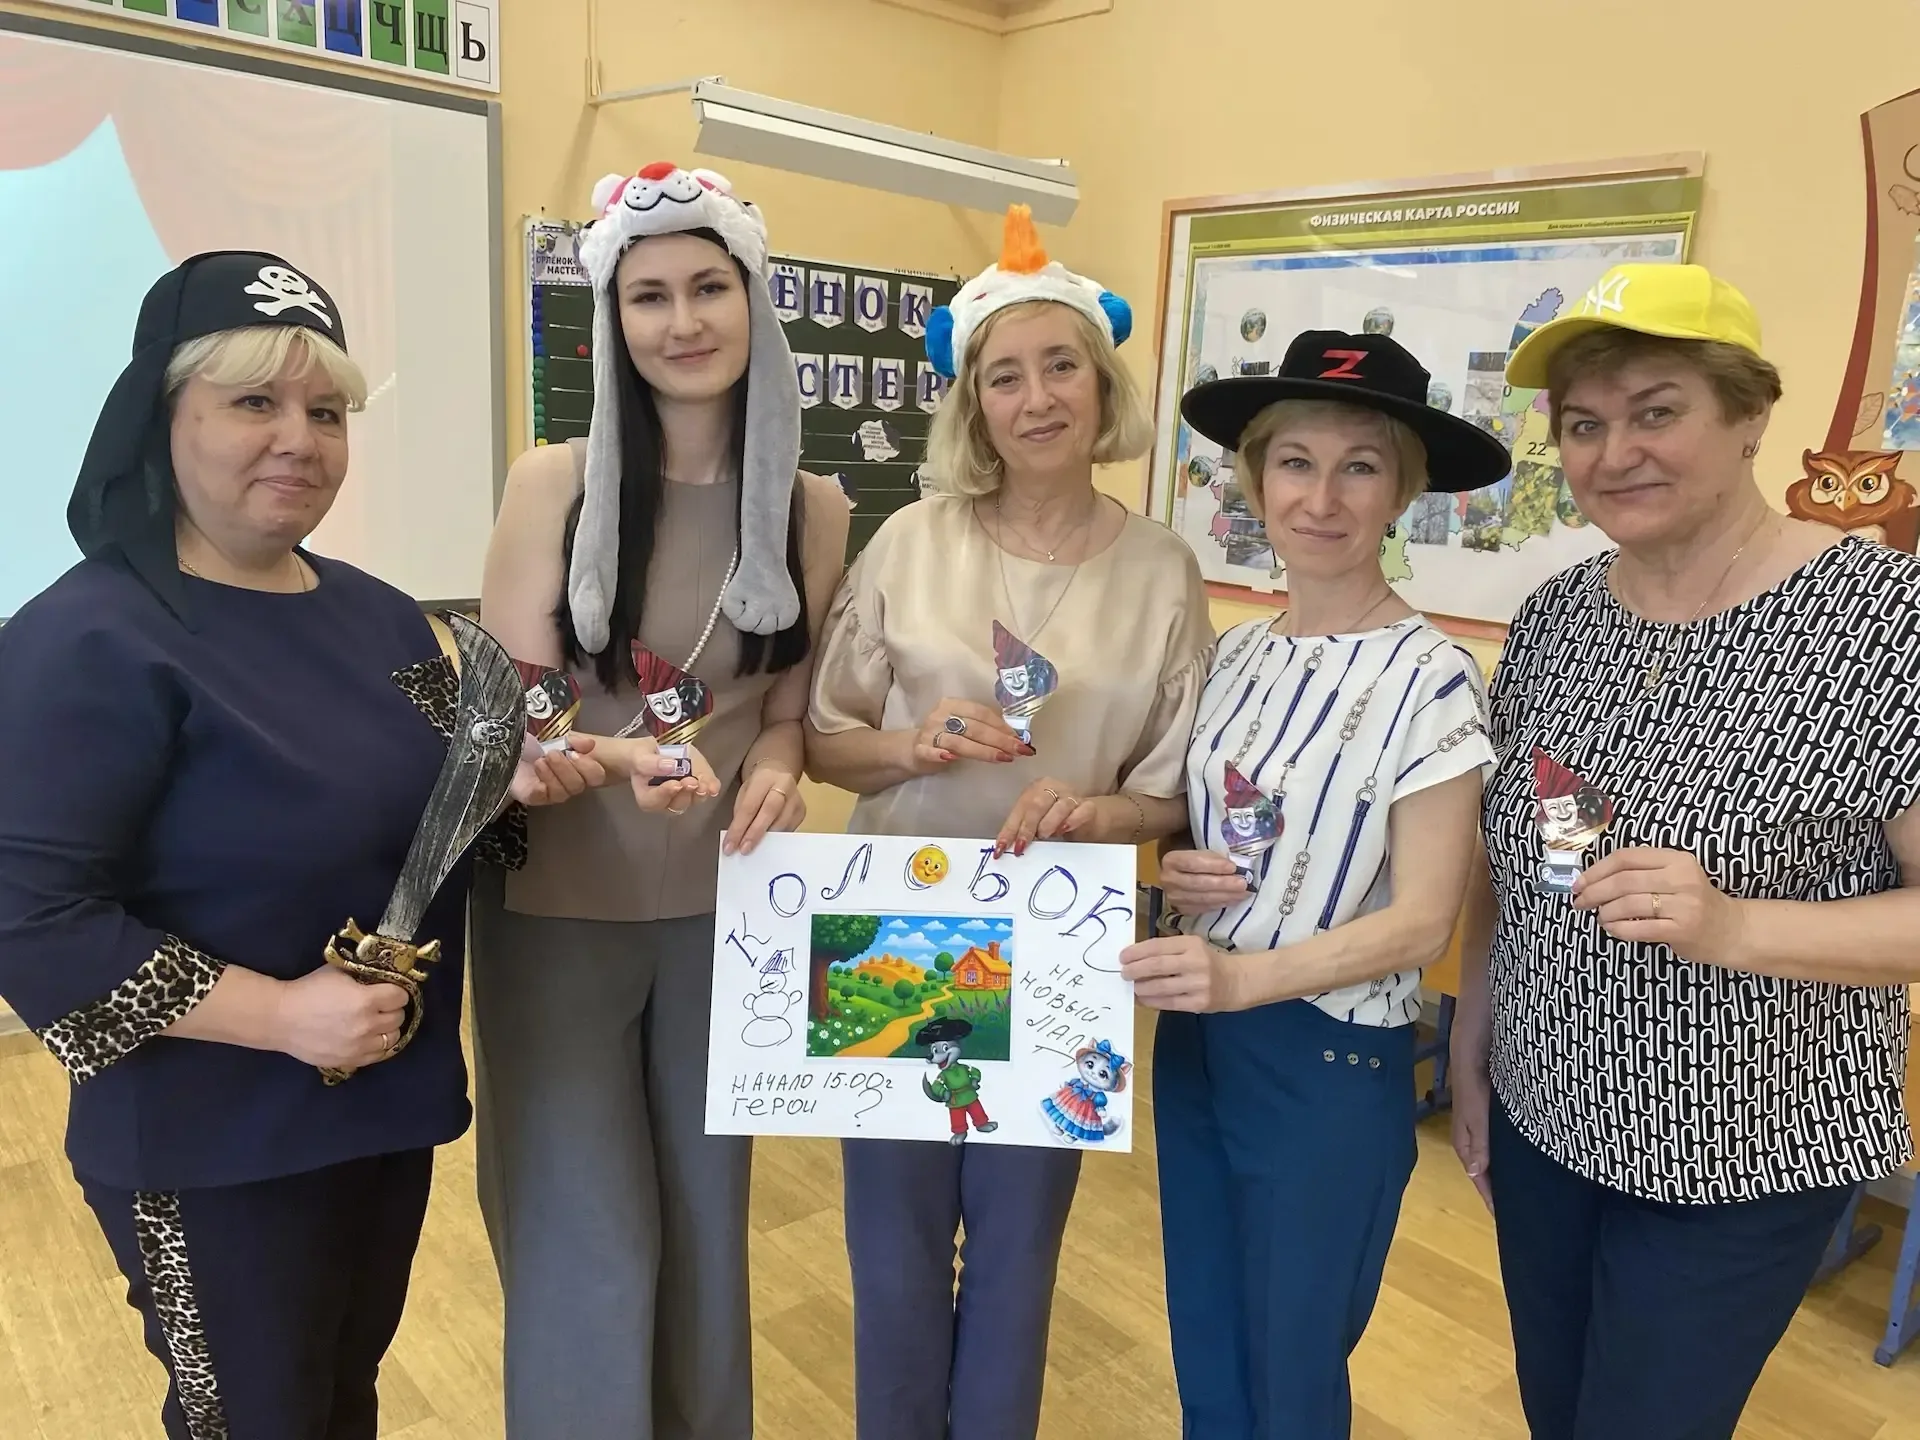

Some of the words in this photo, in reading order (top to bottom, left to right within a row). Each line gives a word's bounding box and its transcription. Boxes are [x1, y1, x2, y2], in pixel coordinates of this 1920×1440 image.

[373, 1, 403, 46] Ч
[416, 11, 448, 66] Щ
[460, 21, 487, 62] Ь
[1310, 208, 1402, 227] ФИЗИЧЕСКАЯ
[1405, 203, 1453, 221] КАРТА
[1456, 201, 1520, 217] РОССИИ
[1316, 349, 1370, 379] Z
[1526, 441, 1547, 456] 22
[1048, 963, 1085, 988] НА
[1019, 970, 1112, 1022] НОВЫЙ
[731, 1071, 815, 1094] НАЧАЛО
